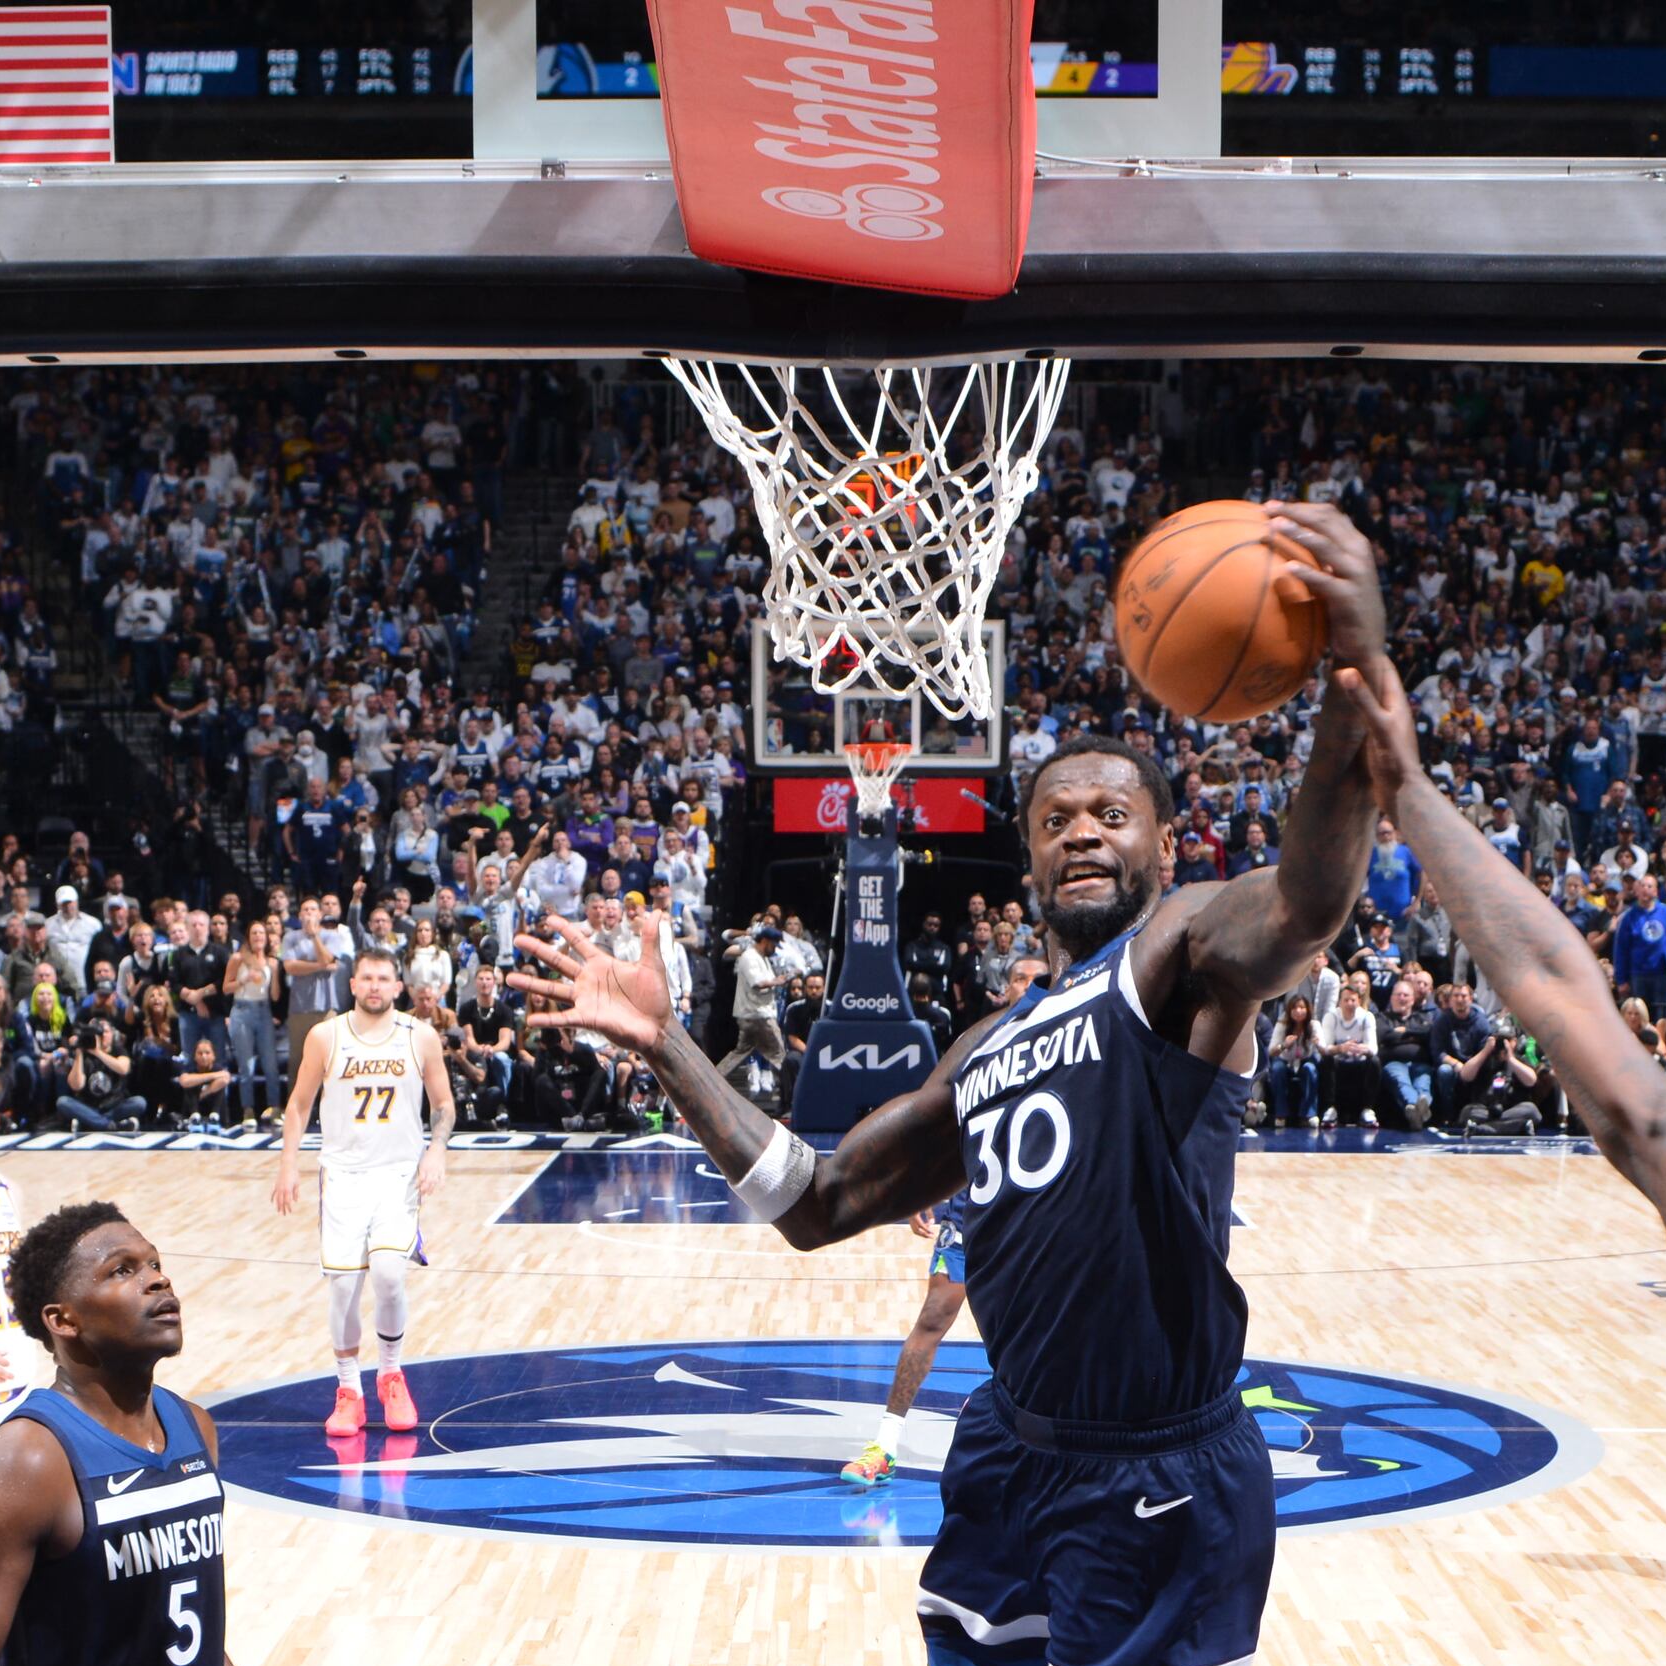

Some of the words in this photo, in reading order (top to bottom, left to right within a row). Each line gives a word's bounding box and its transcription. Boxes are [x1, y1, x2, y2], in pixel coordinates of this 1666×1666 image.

[1105, 69, 1120, 88] 2
[725, 0, 941, 184] StateFa
[859, 876, 884, 897] GET
[859, 898, 884, 919] THE
[864, 919, 890, 946] App
[1372, 970, 1392, 987] 27
[841, 993, 899, 1014] Google
[339, 1056, 406, 1081] LAKERS
[954, 1013, 1102, 1127] MINNESOTA
[354, 1086, 396, 1123] 77
[967, 1091, 1071, 1205] 30
[165, 1578, 202, 1666] 5
